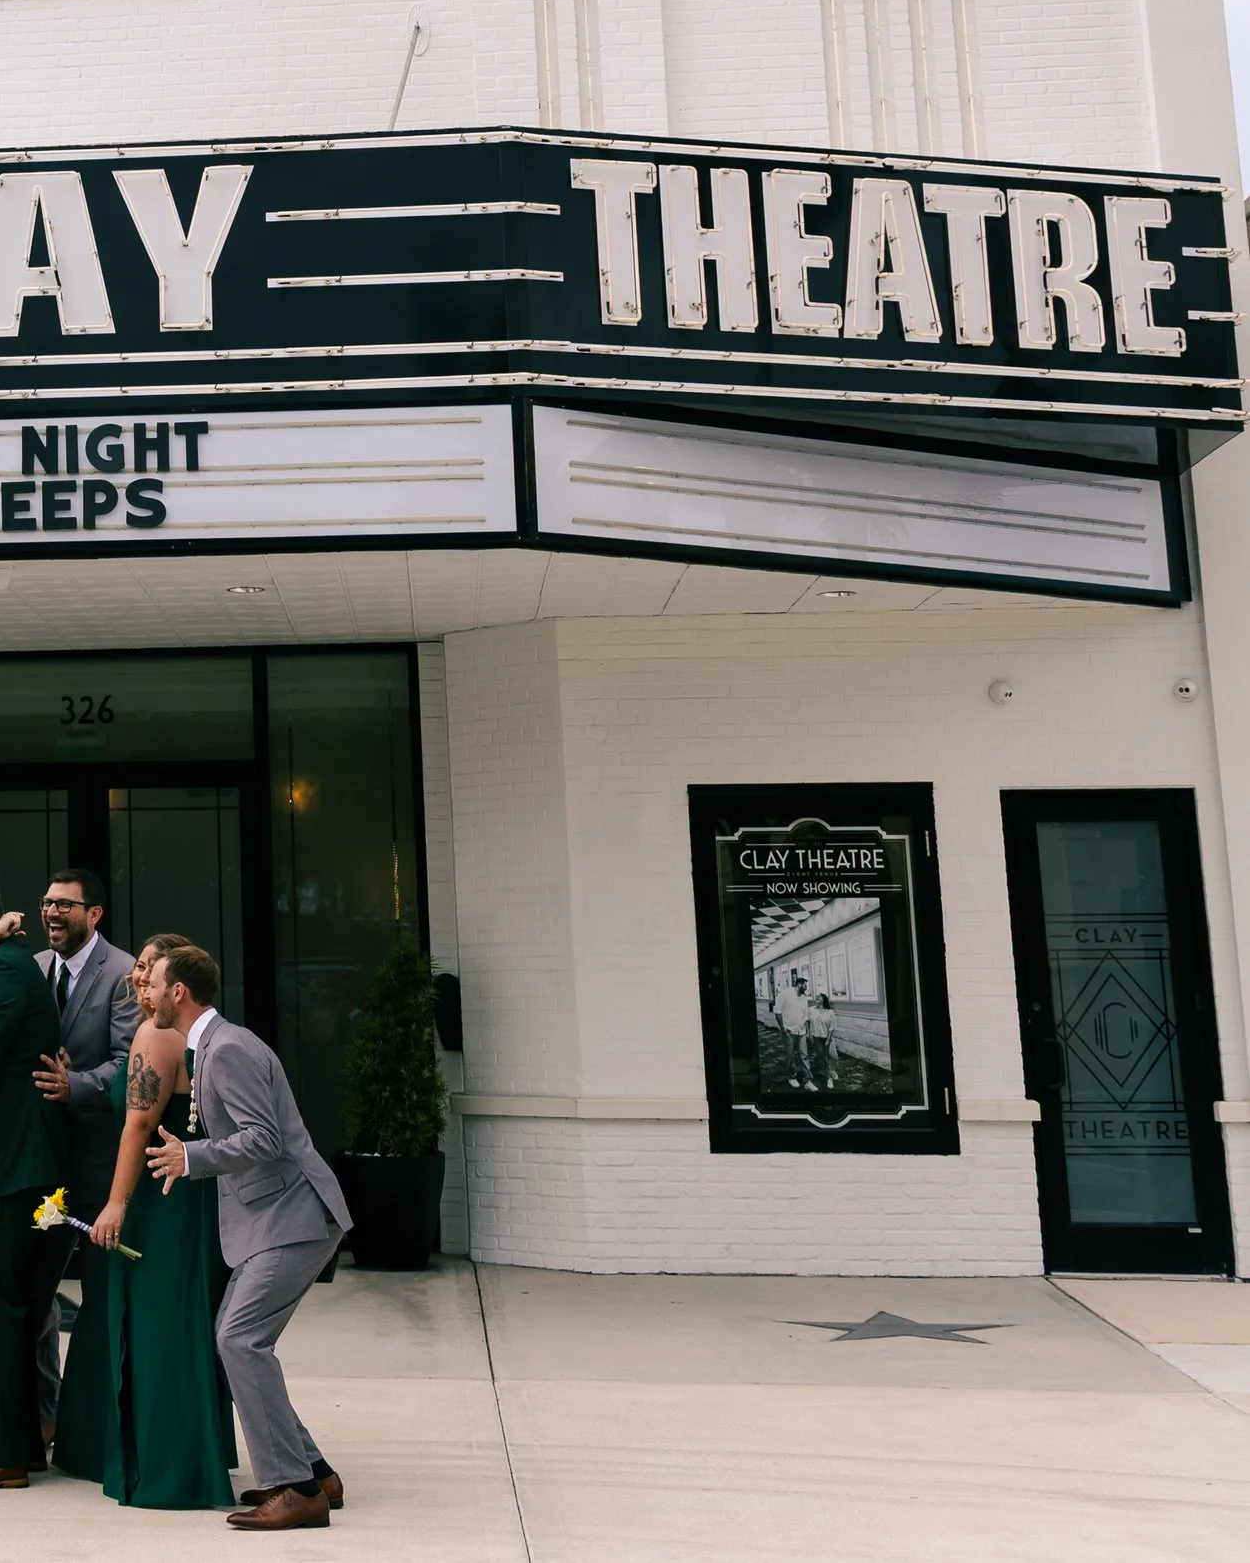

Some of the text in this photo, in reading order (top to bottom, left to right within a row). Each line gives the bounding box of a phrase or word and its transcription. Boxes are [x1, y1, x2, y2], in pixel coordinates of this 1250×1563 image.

[570, 159, 1186, 357] THEATRE
[20, 420, 209, 476] NIGHT
[60, 694, 115, 725] 326
[740, 849, 885, 869] CLAY THEATRE
[767, 882, 861, 894] NOW SHOWING
[1075, 928, 1137, 943] CLAY
[1063, 1120, 1187, 1139] THEATRE
